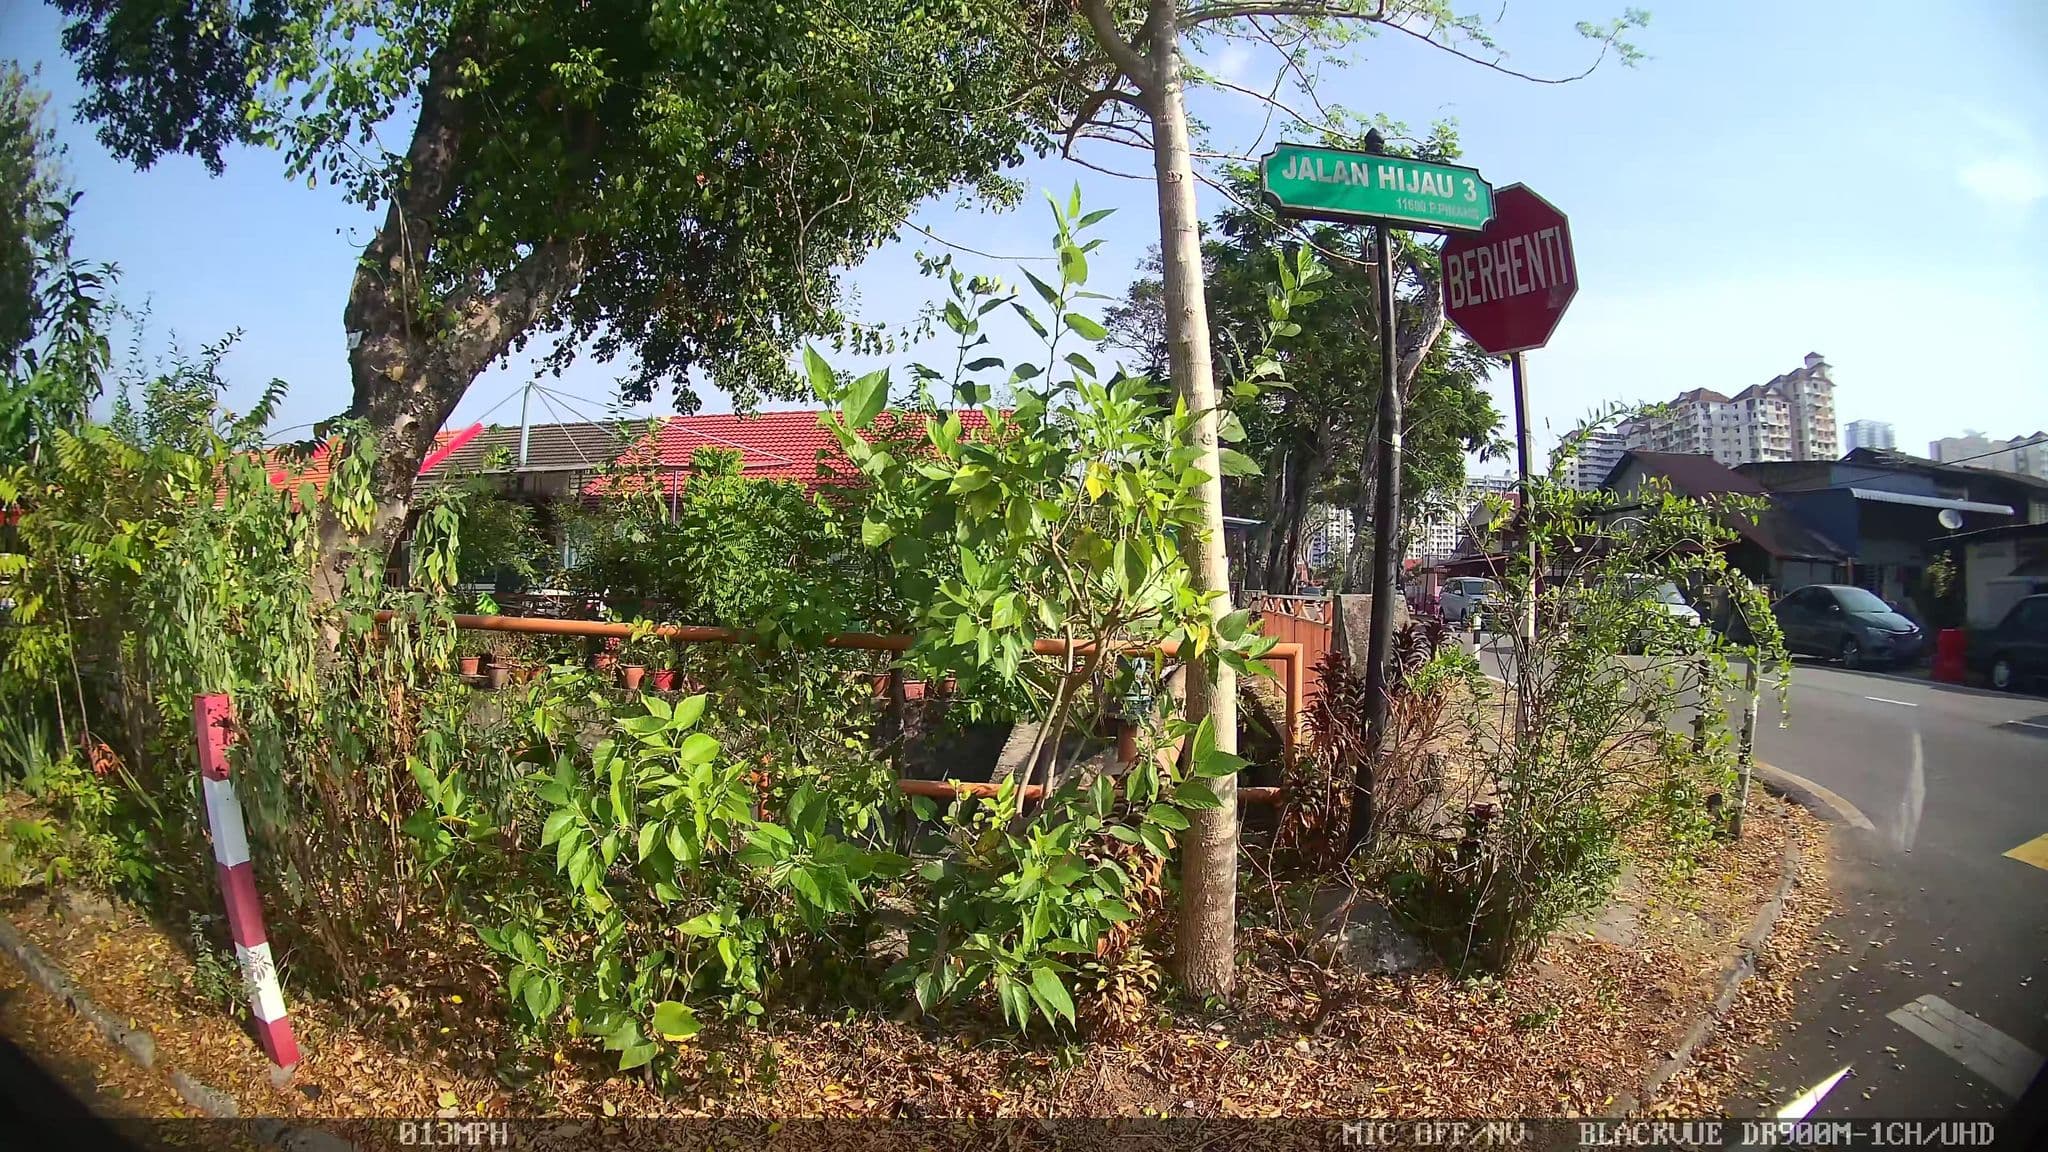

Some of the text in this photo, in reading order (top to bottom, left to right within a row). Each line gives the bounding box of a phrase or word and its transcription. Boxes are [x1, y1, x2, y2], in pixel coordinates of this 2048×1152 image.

[1282, 155, 1477, 202] JALAN HIJAU 3
[1446, 224, 1569, 310] BERHENTI
